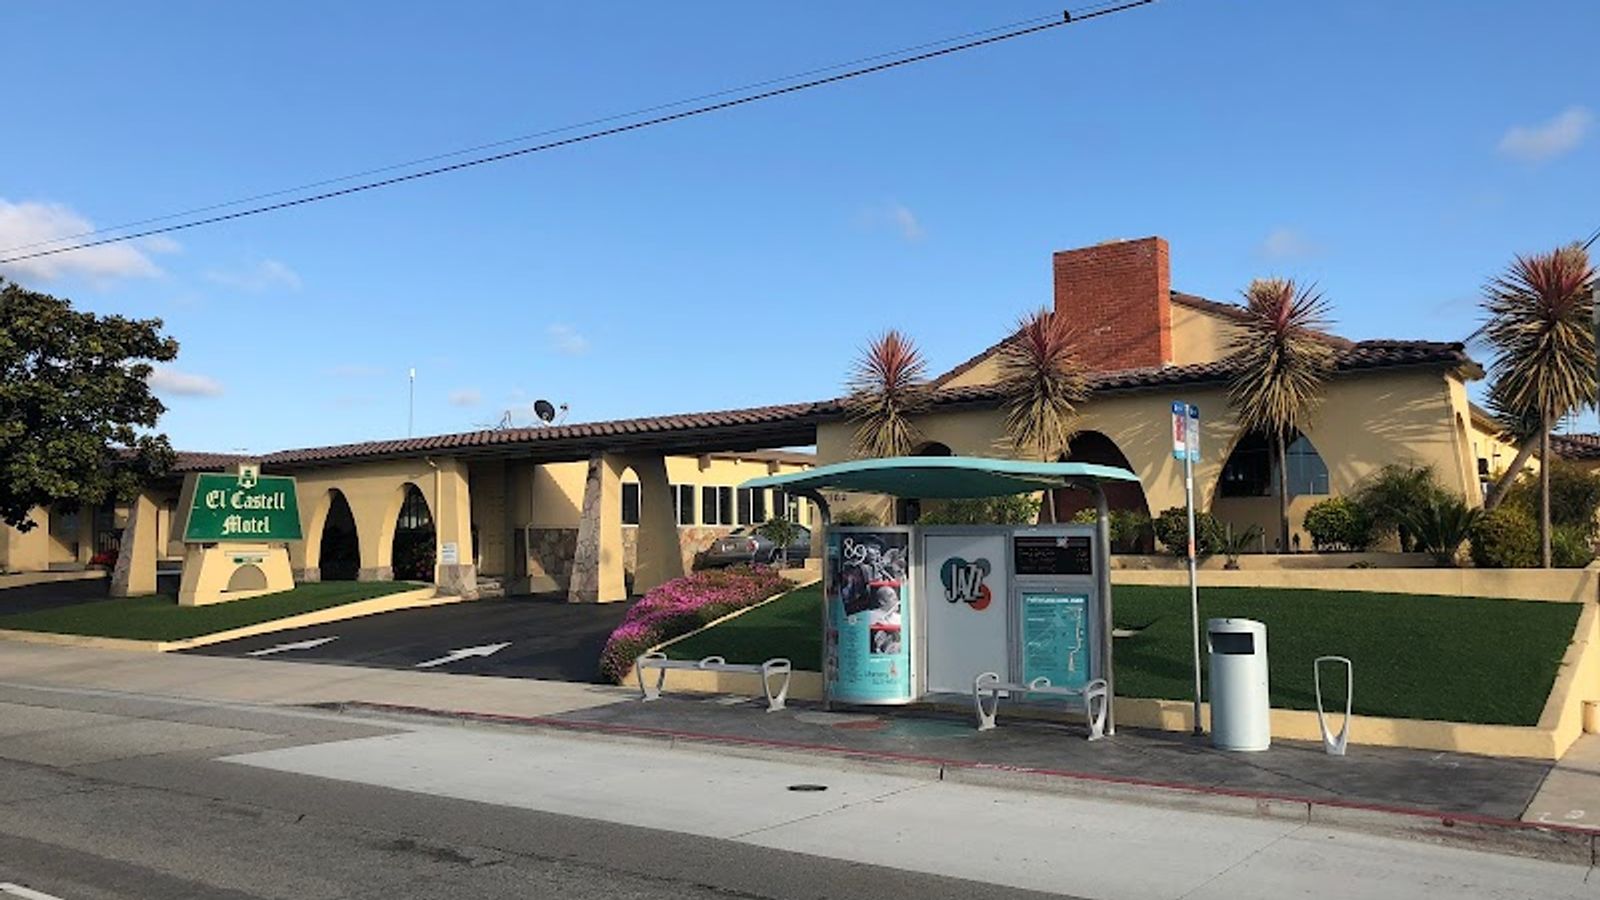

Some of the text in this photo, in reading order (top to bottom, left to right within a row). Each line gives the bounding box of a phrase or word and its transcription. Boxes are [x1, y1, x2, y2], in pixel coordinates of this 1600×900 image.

[206, 490, 285, 510] El Castell
[221, 514, 270, 535] Motel
[945, 562, 984, 602] JAZZ
